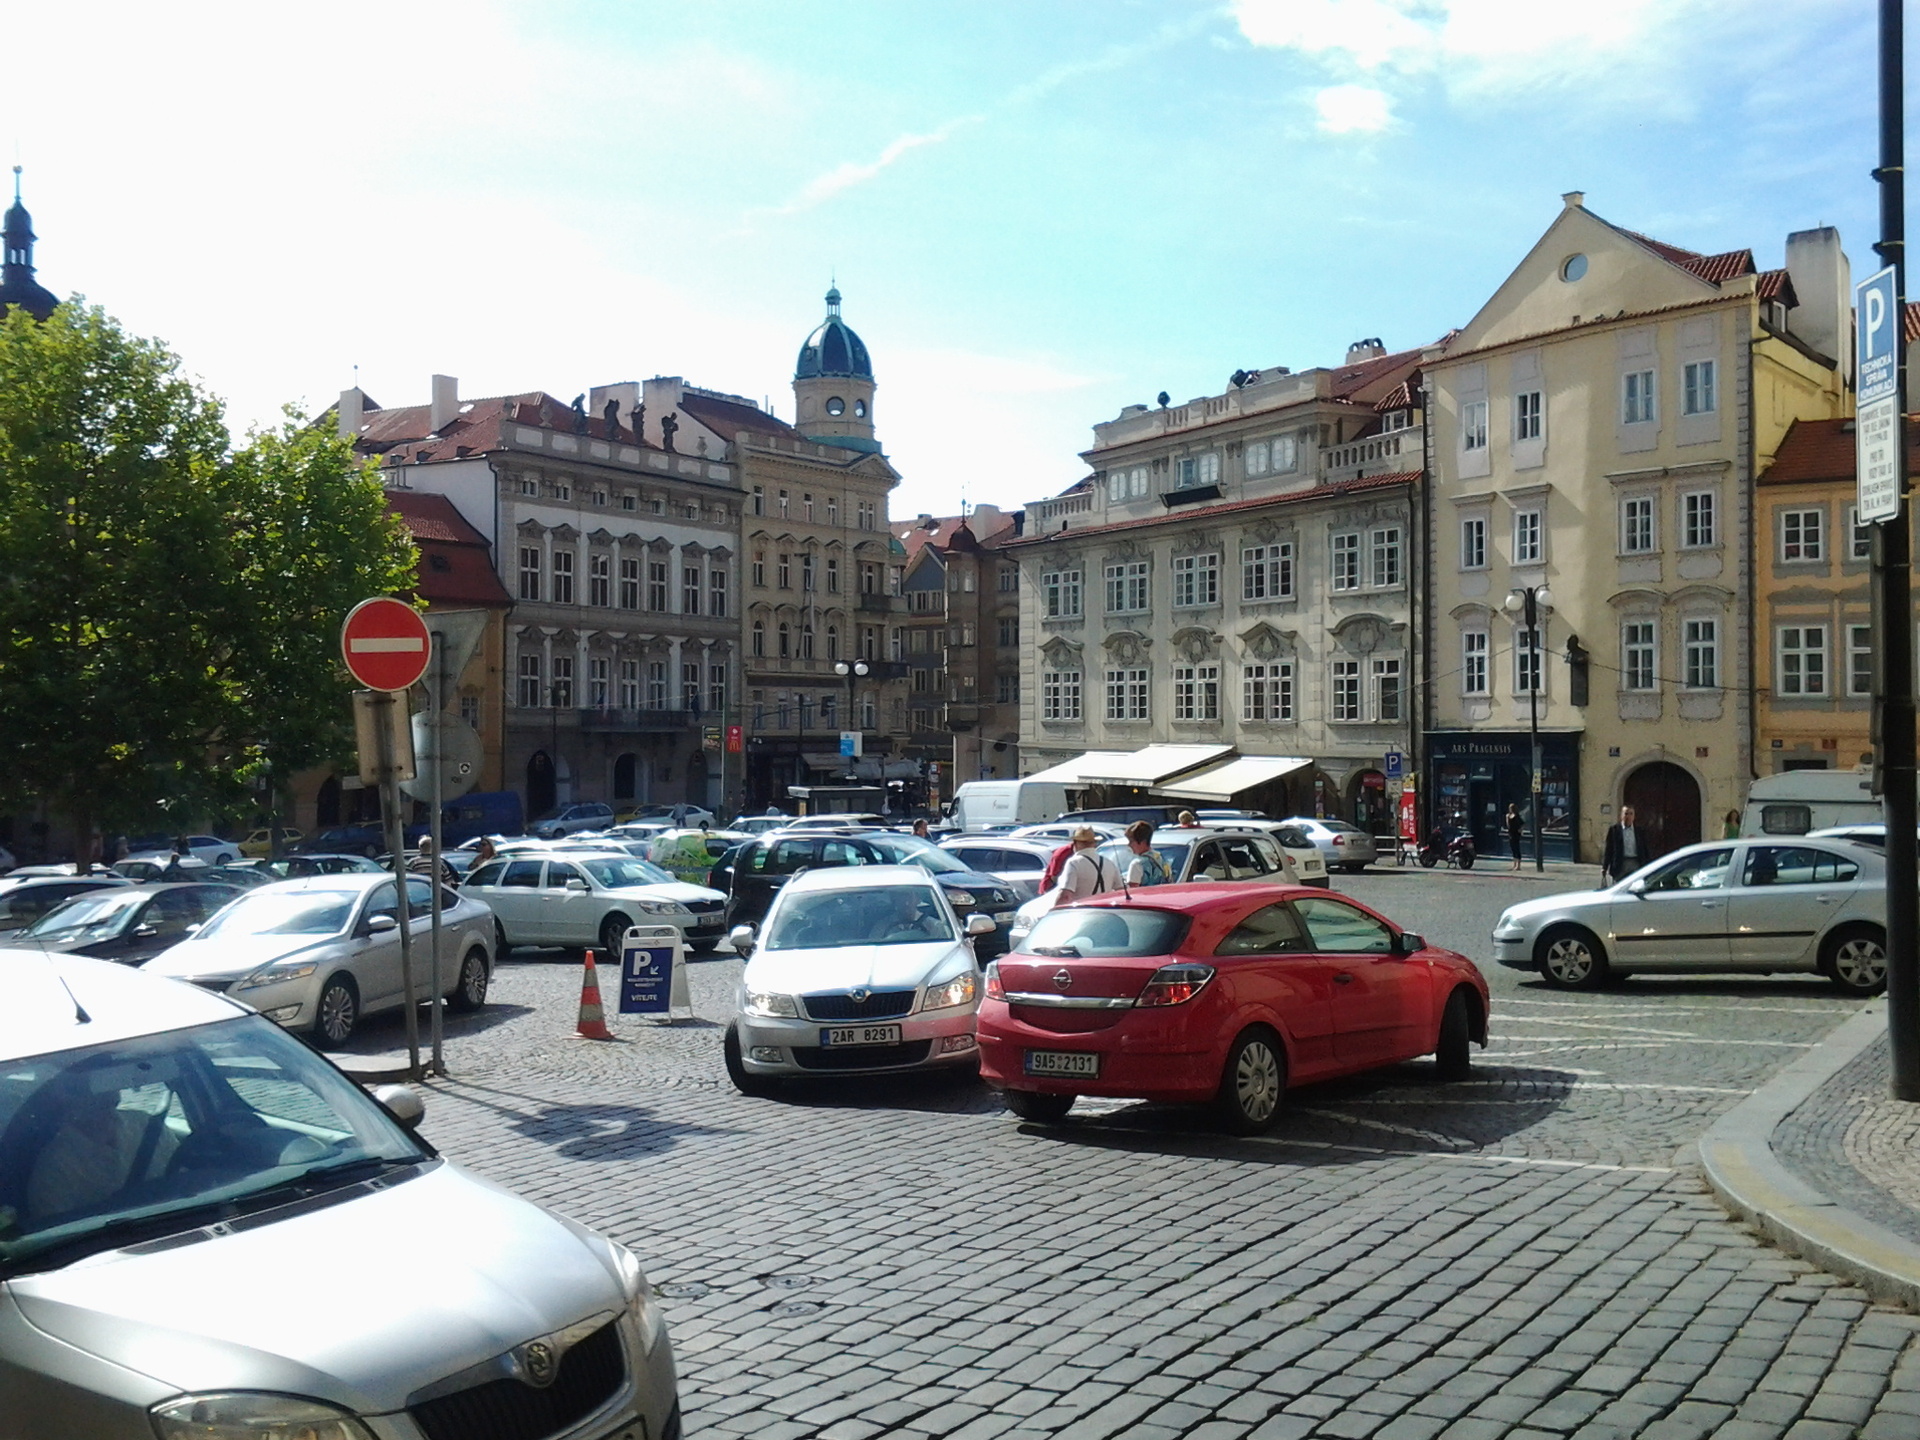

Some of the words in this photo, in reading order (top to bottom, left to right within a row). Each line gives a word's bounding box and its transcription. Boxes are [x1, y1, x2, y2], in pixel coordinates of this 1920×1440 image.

[1866, 288, 1885, 360] P
[1388, 755, 1399, 770] P
[632, 950, 653, 976] P
[831, 1028, 856, 1043] 2AR
[863, 1027, 895, 1042] 8291
[1034, 1053, 1055, 1070] 9A5
[1063, 1055, 1094, 1072] 2131
